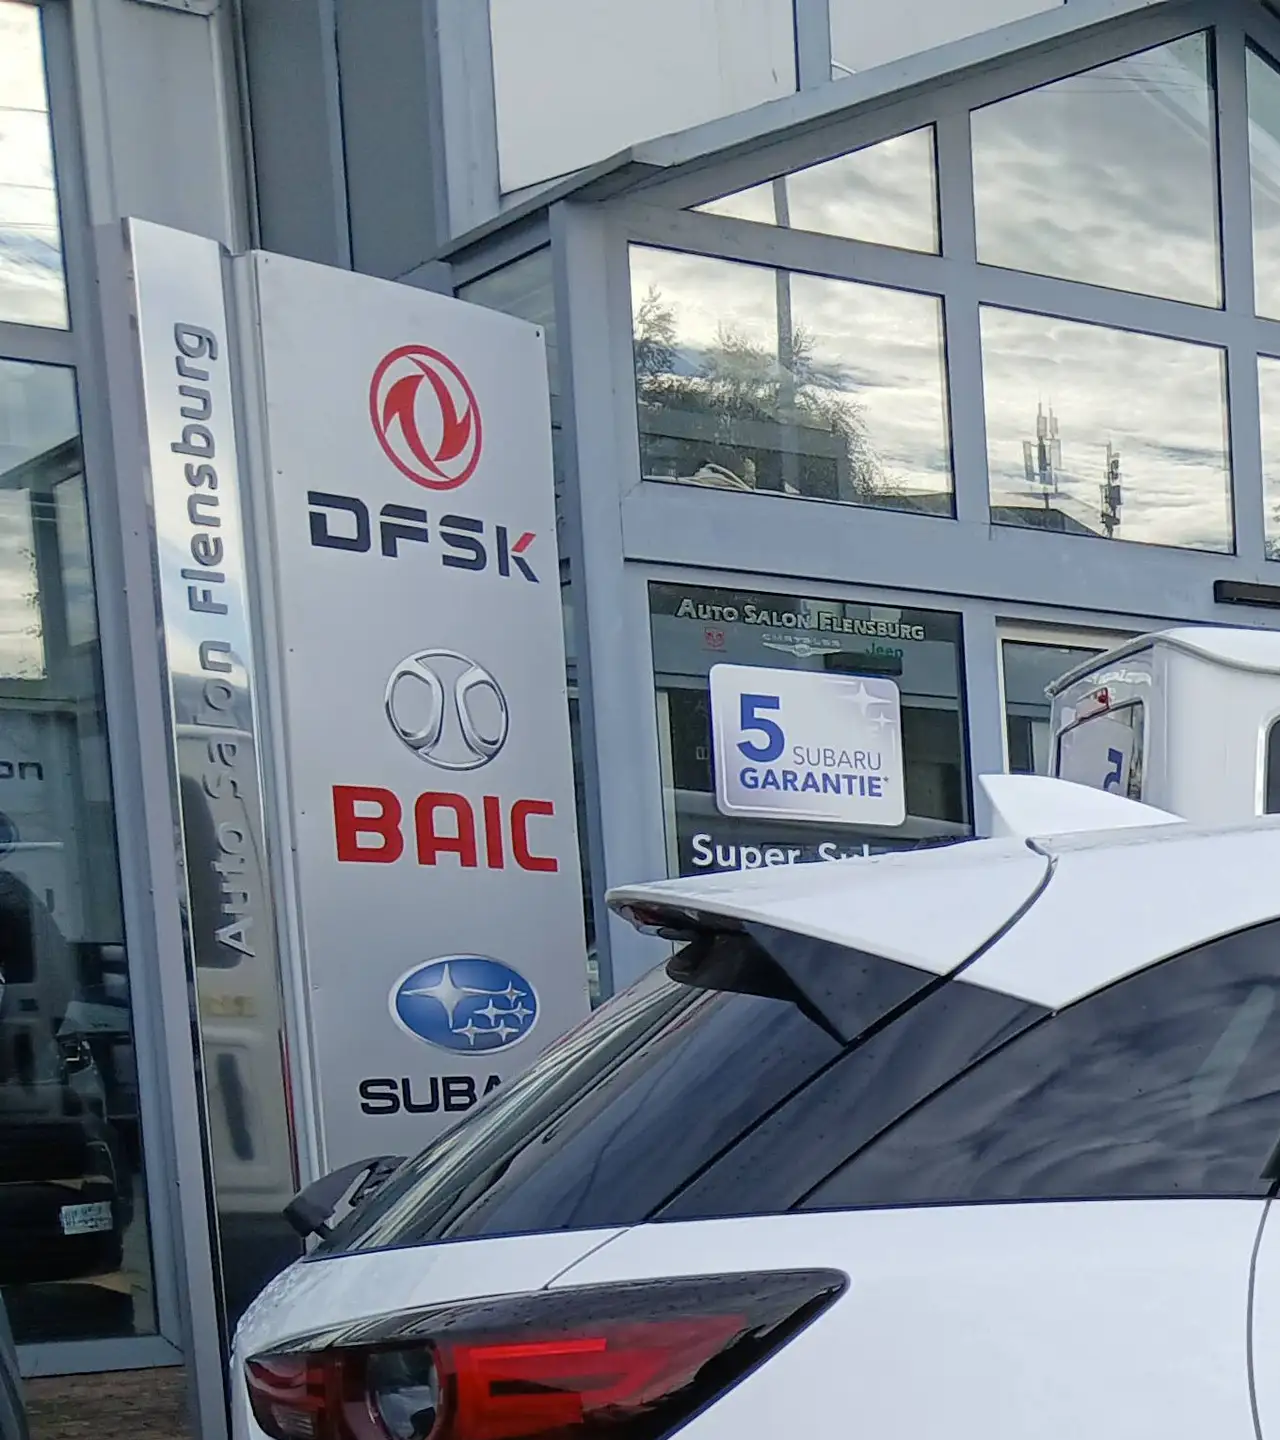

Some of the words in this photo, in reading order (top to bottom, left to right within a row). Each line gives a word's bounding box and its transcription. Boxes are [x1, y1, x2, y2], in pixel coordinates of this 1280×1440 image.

[171, 322, 228, 616] Flensburg
[307, 490, 540, 583] DFSK
[736, 693, 785, 763] 5
[793, 746, 882, 770] SUBARU
[332, 785, 559, 872] BAIC
[692, 833, 801, 872] Super
[211, 820, 256, 958] Auto
